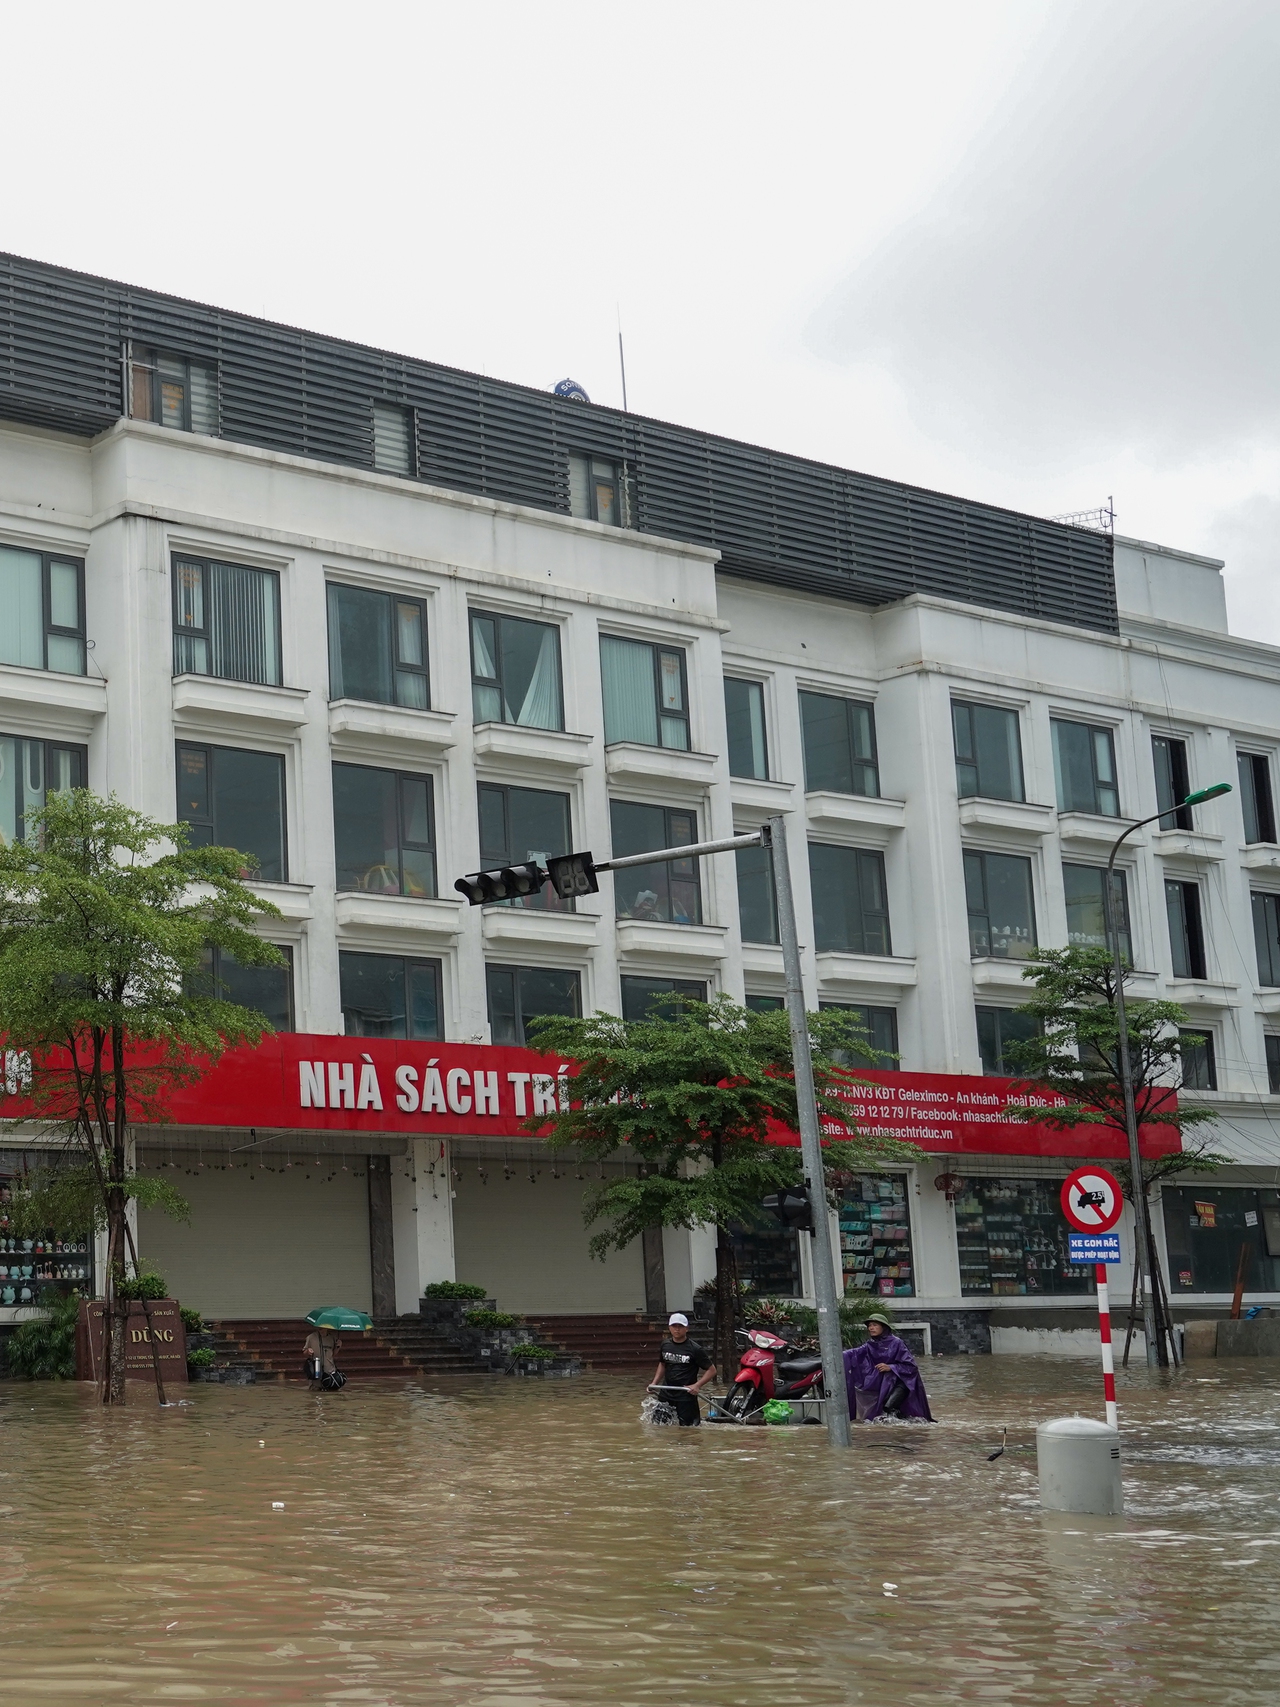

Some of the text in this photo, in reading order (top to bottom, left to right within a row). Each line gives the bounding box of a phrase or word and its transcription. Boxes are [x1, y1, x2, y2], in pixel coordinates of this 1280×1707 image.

[299, 1053, 383, 1110] NHÀ
[395, 1058, 499, 1115] SÁCH
[507, 1064, 570, 1116] TRÍ
[875, 1087, 896, 1099] KĐT
[898, 1090, 948, 1102] Geleximco
[956, 1092, 969, 1104] An
[970, 1092, 999, 1105] khánh
[1007, 1094, 1028, 1106] Hoài
[1029, 1095, 1047, 1107] Đức
[1054, 1096, 1066, 1108] Hà
[868, 1105, 878, 1117] 12
[880, 1106, 890, 1118] 12
[892, 1107, 904, 1118] 79
[911, 1107, 962, 1121] Facebook:
